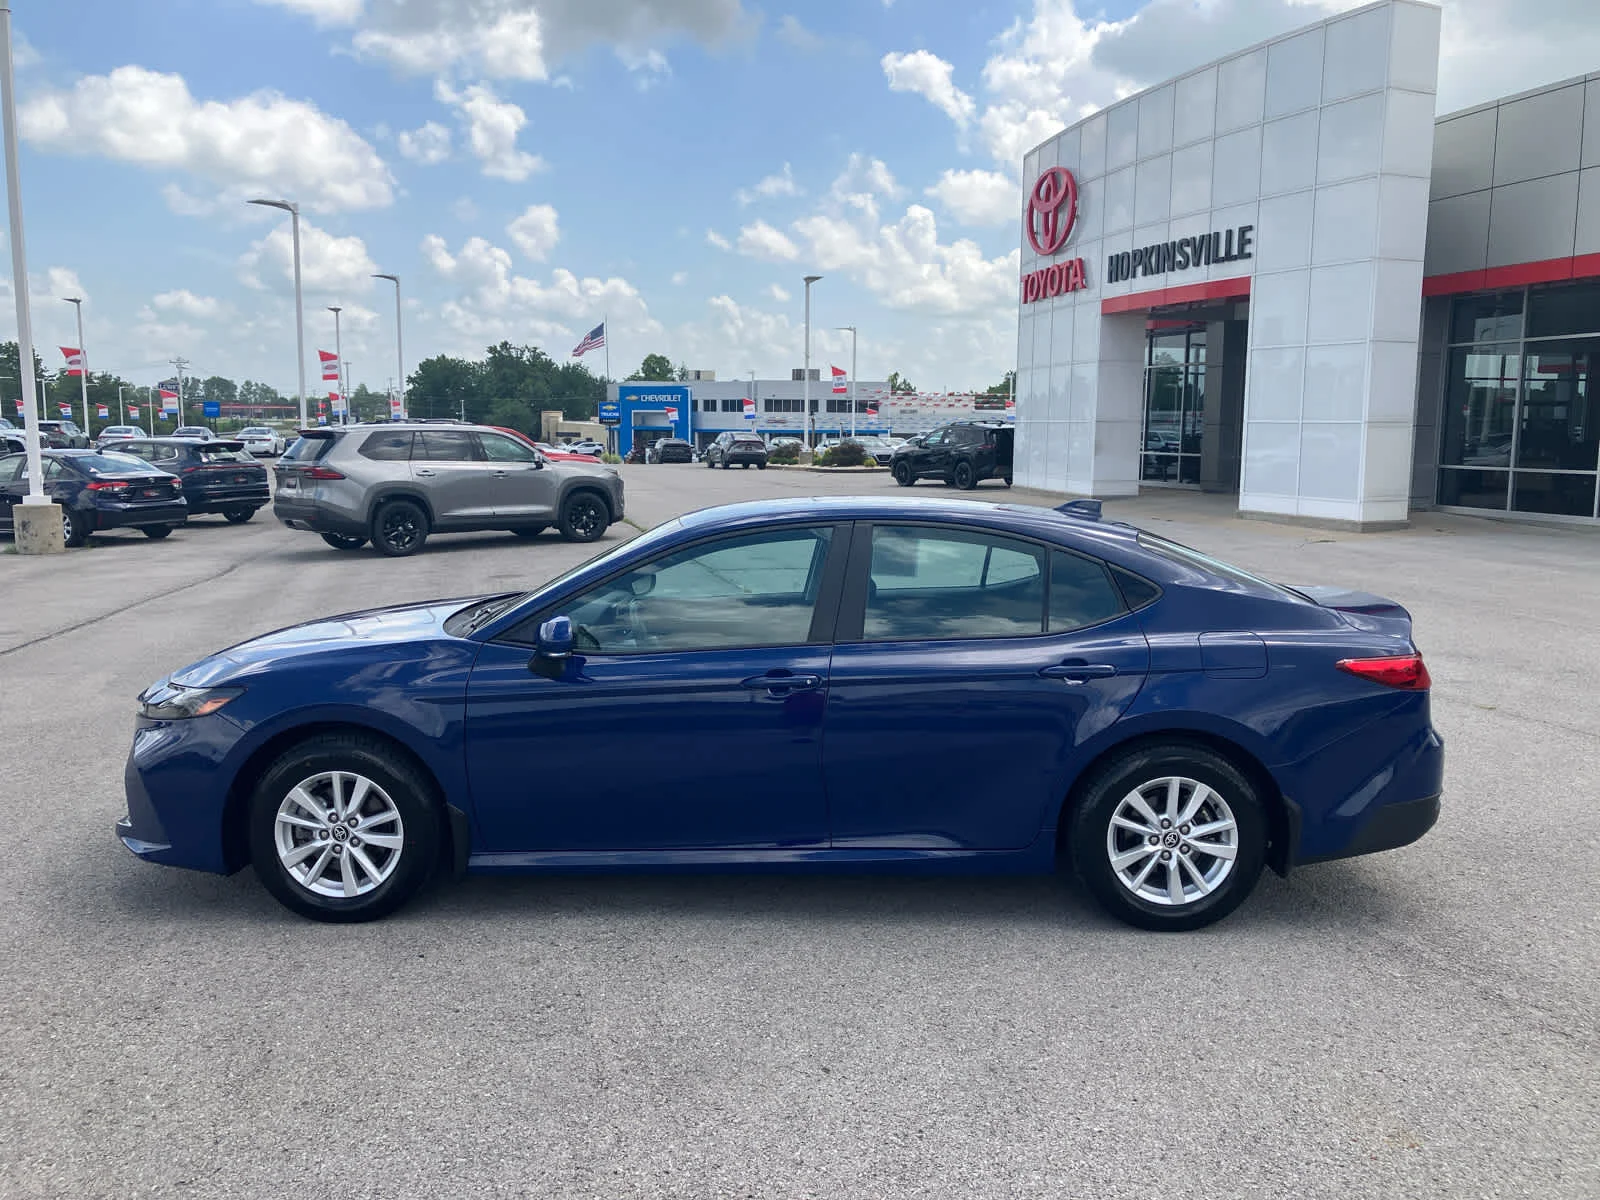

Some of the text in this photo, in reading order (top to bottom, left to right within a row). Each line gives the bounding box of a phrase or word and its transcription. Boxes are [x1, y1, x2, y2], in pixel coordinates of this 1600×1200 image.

[1107, 225, 1253, 283] HOPKINSVILLE
[1021, 257, 1087, 304] TOYOTA
[640, 394, 681, 402] CHEVROLET
